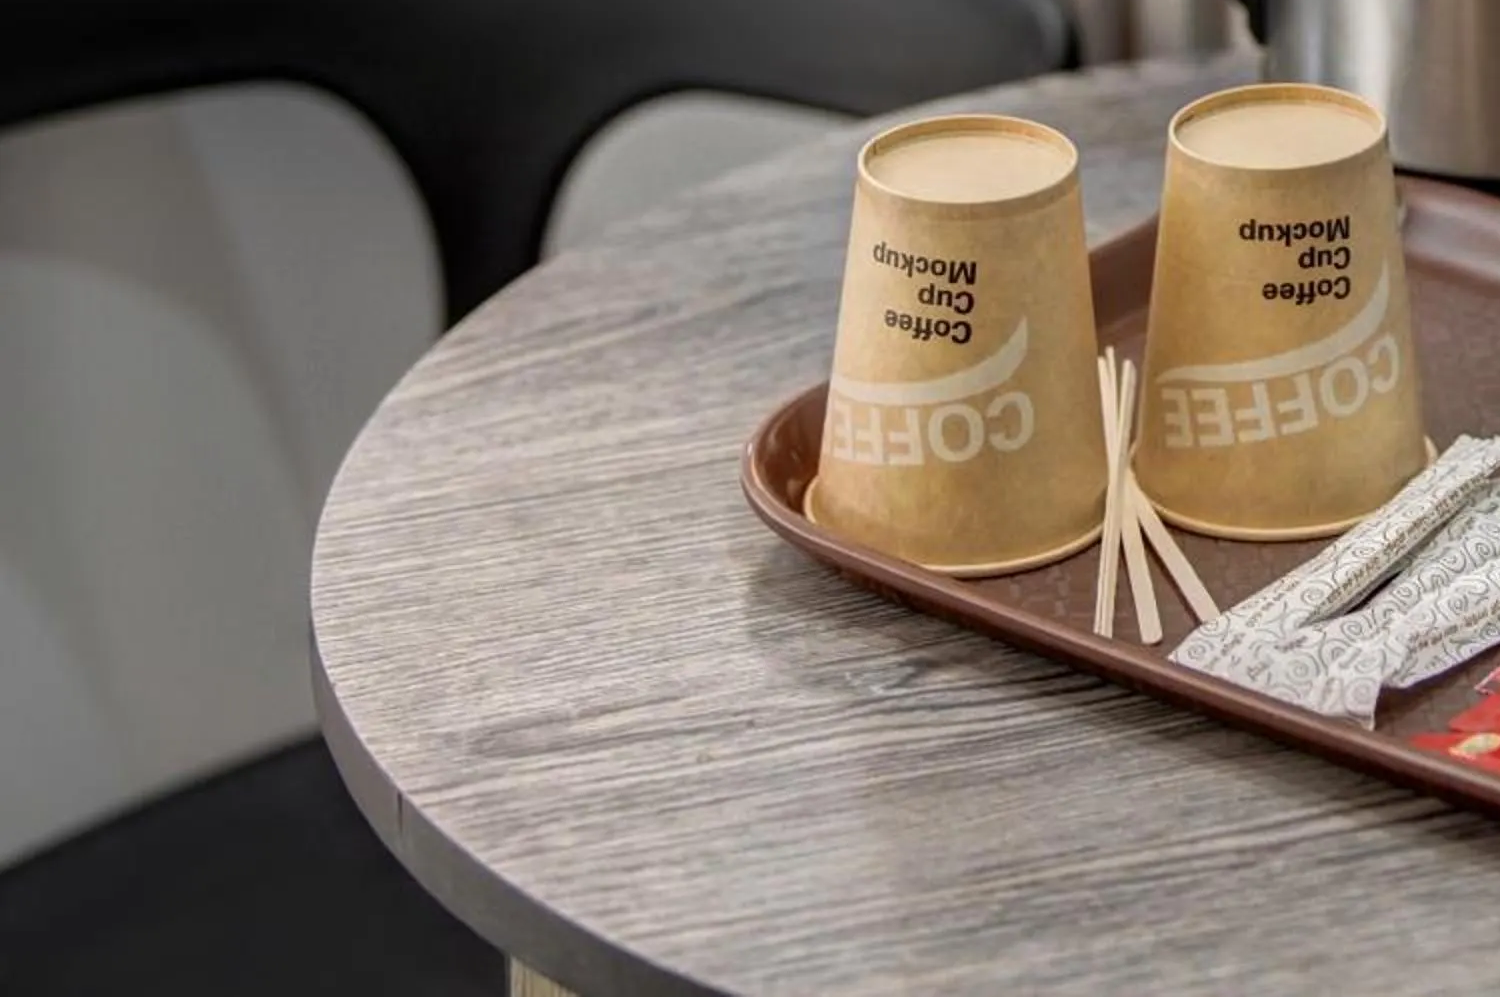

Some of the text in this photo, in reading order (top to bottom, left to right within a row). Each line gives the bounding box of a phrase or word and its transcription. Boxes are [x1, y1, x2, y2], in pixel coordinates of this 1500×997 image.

[1239, 215, 1351, 247] Mockup
[872, 241, 978, 286] Mockup
[1297, 246, 1351, 271] Cup
[917, 283, 976, 316] Cup
[1261, 275, 1351, 306] Coffee
[884, 308, 973, 345] Coffee
[1160, 331, 1400, 449] COFFEE
